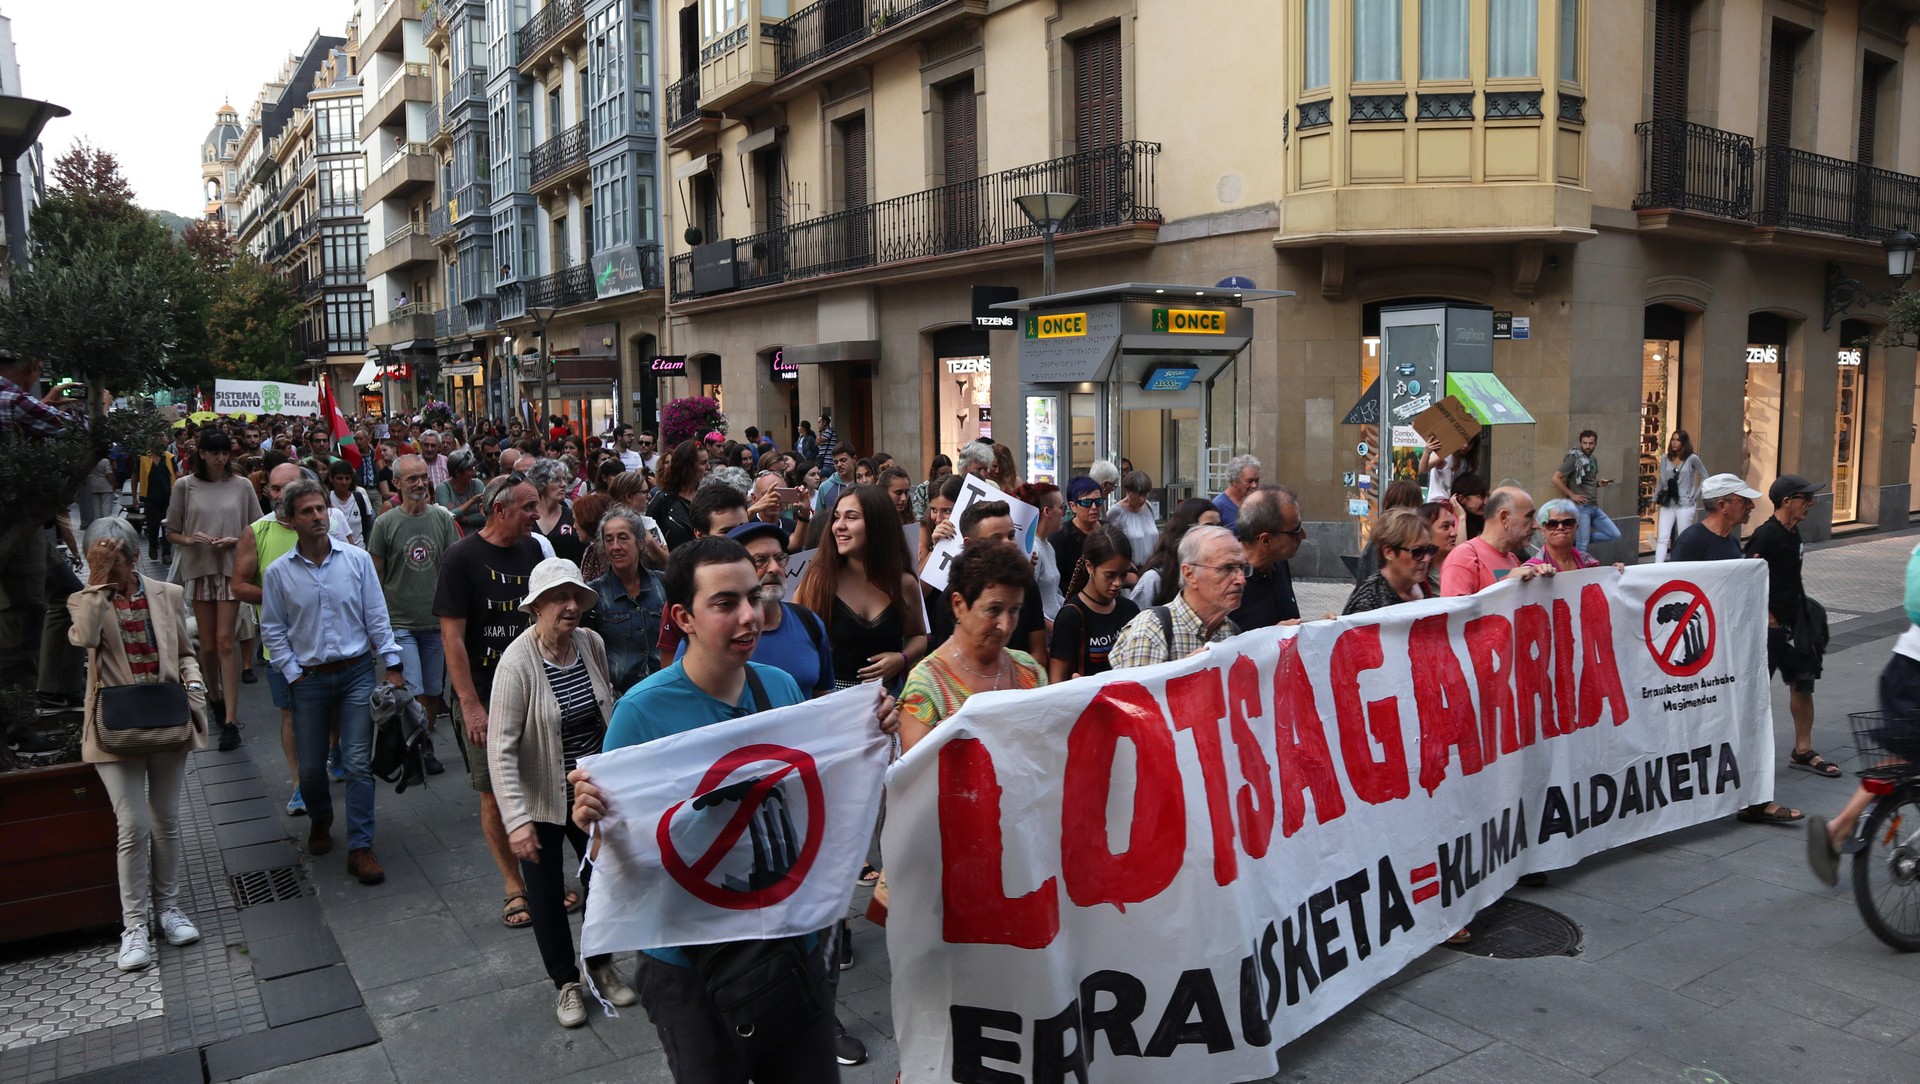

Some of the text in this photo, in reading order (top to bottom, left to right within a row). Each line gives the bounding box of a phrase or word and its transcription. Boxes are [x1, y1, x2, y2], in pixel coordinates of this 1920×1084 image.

[1043, 317, 1082, 334] ONCE
[1175, 313, 1220, 330] ONCE
[651, 358, 684, 370] Etam
[215, 392, 260, 400] SISTEMA
[218, 400, 260, 408] ALDATU
[484, 626, 506, 637] SKAPA
[1663, 695, 1717, 712] Mugimendua
[939, 583, 1630, 949] LOTSAGARRIA
[1538, 742, 1741, 845] ALDAKETA
